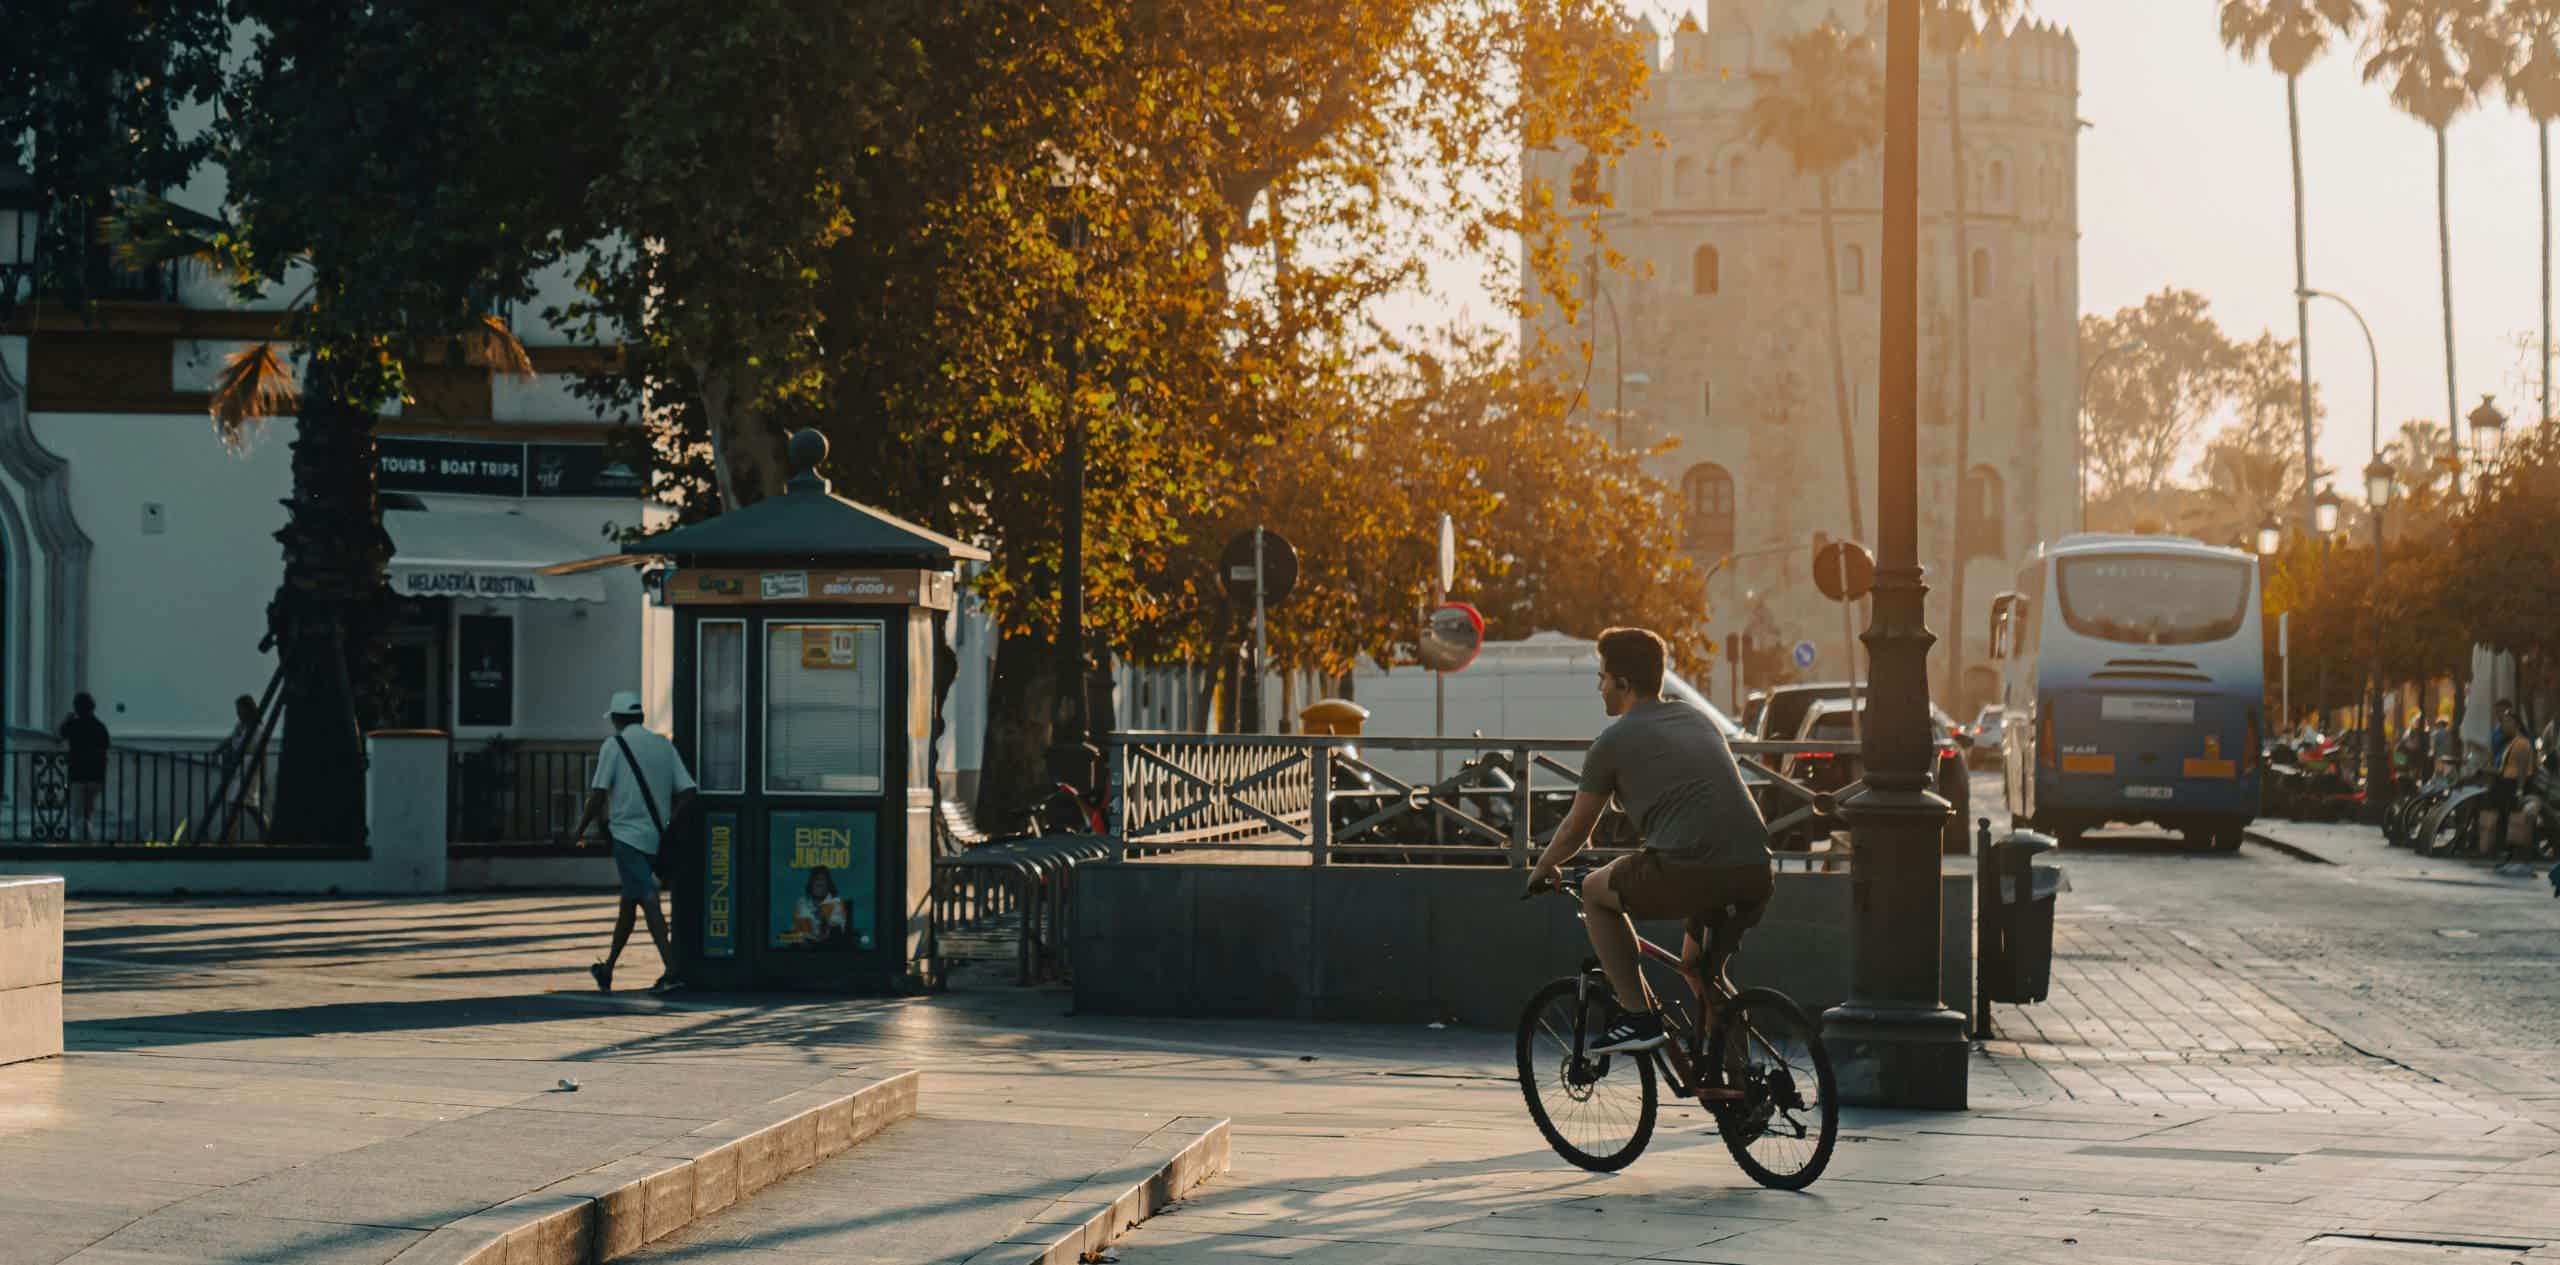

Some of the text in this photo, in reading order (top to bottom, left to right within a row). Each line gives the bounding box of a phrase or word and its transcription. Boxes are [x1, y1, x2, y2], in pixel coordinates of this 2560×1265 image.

[381, 457, 426, 473] TOURS
[440, 459, 476, 475] BOAT
[481, 461, 519, 477] TRIPS
[480, 575, 535, 593] CRISTINA
[795, 827, 850, 848] BIEN
[789, 848, 850, 869] JUGADO
